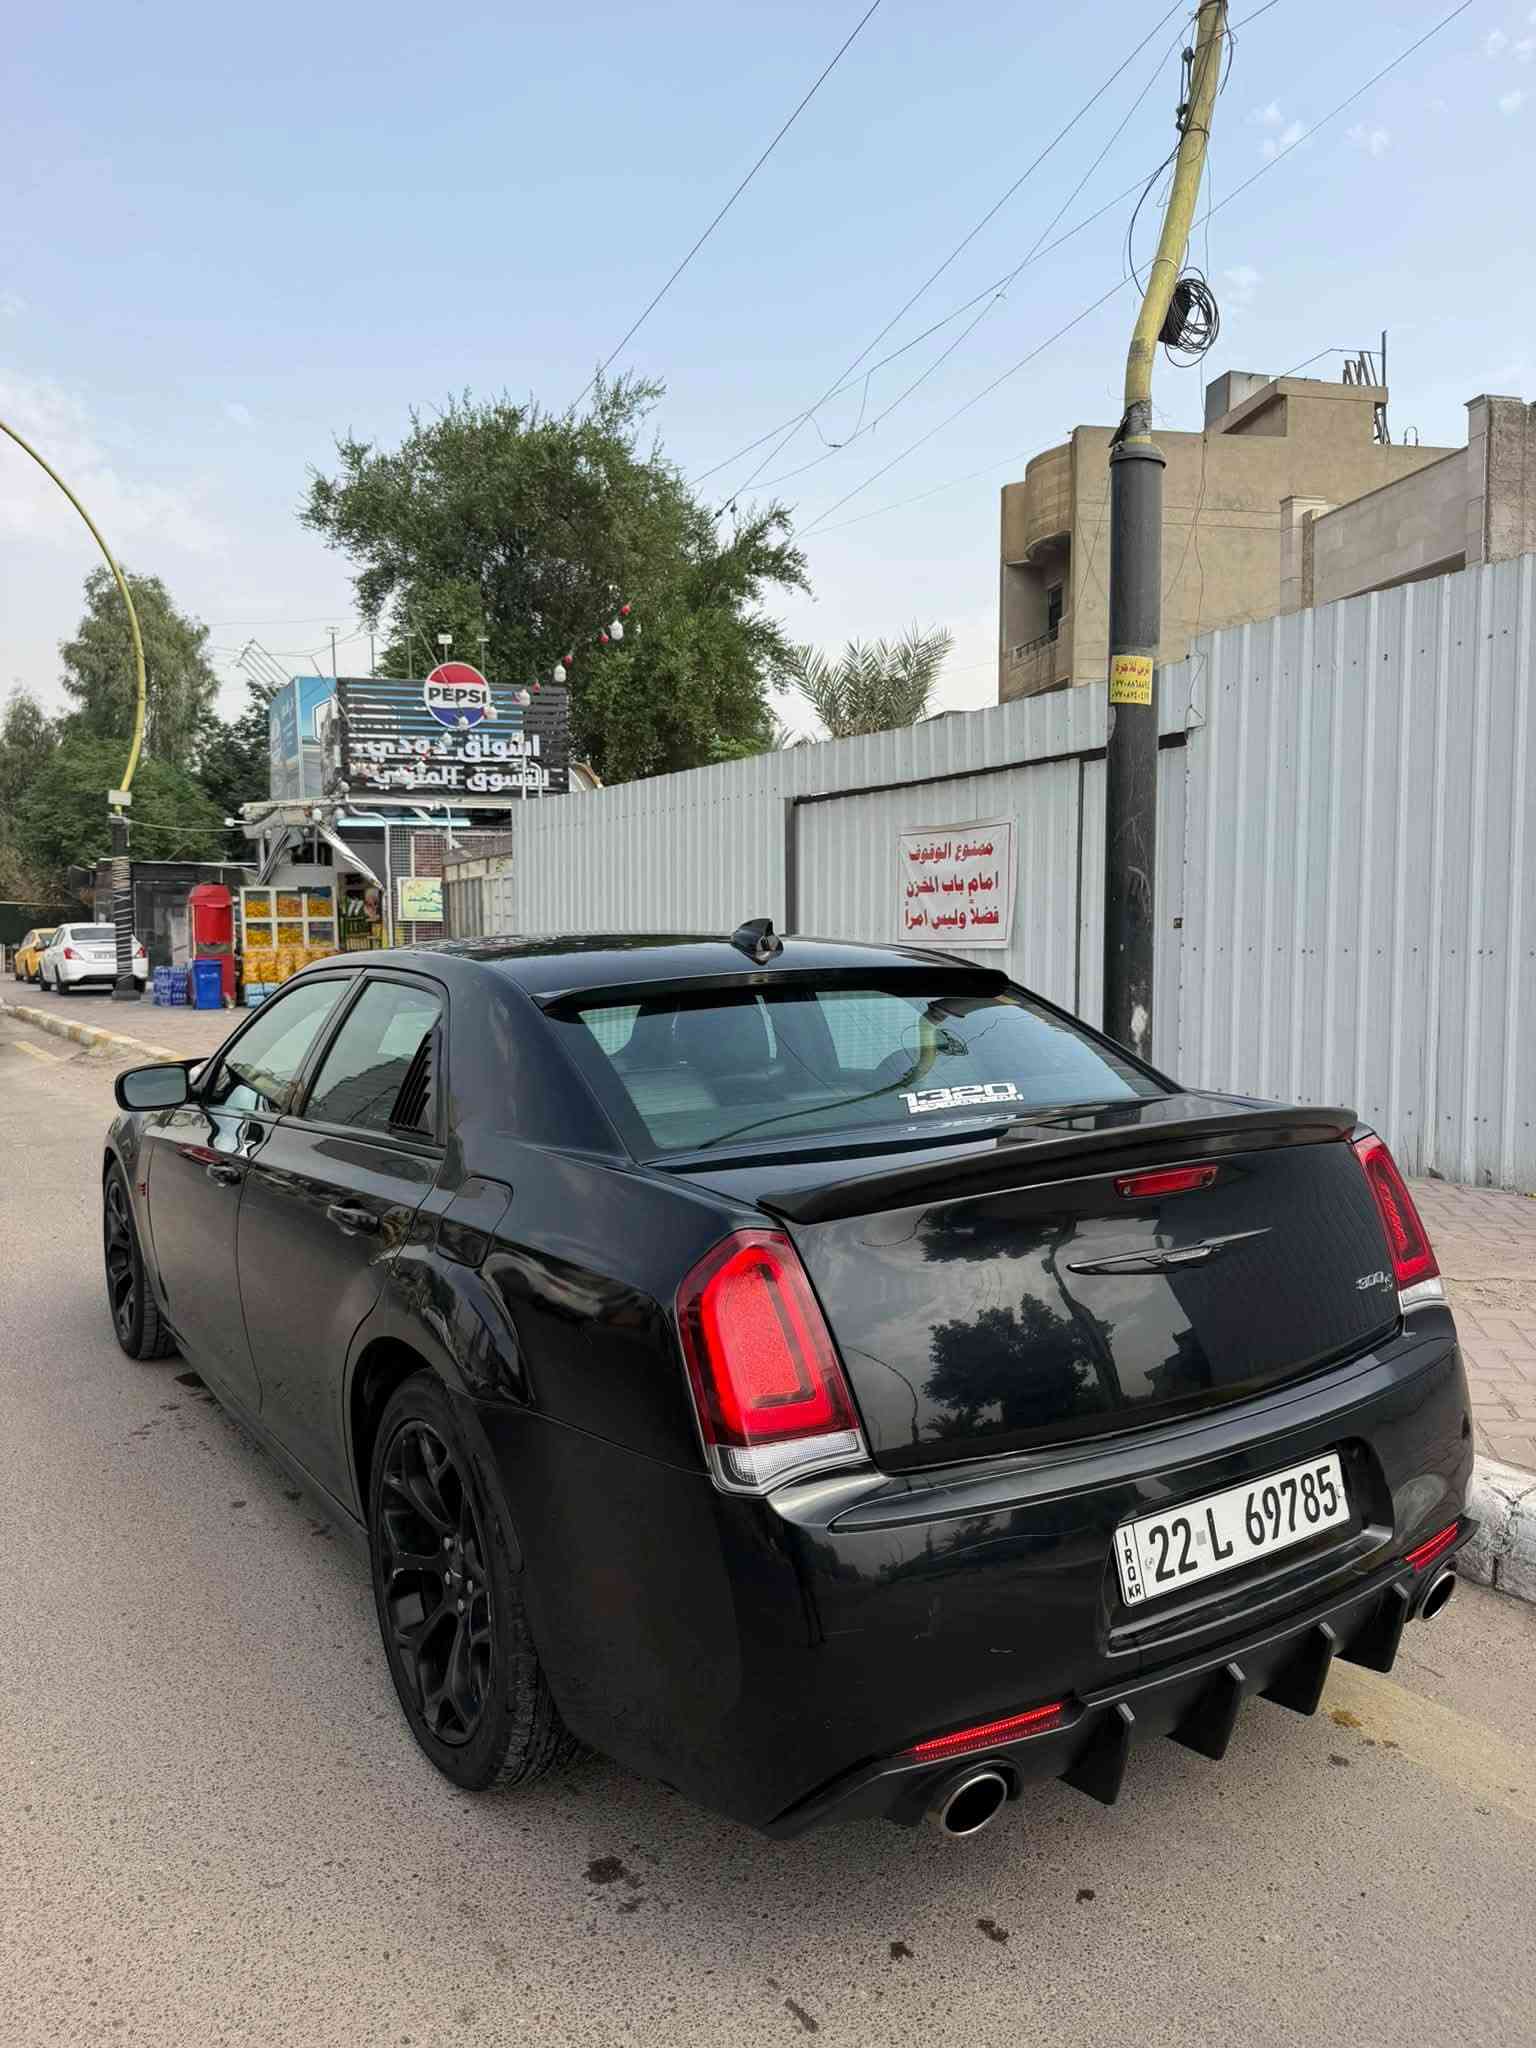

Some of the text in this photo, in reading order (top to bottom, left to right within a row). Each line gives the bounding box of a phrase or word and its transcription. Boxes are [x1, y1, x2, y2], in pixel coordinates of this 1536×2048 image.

[429, 687, 487, 704] PEPSI
[456, 734, 540, 763] اسواق
[909, 840, 994, 864] ممنوع الوقوف
[907, 871, 999, 898] امام باب المخزن
[932, 908, 966, 930] وليس
[1149, 1464, 1338, 1582] 22 L 69785
[1127, 1583, 1141, 1599] KR
